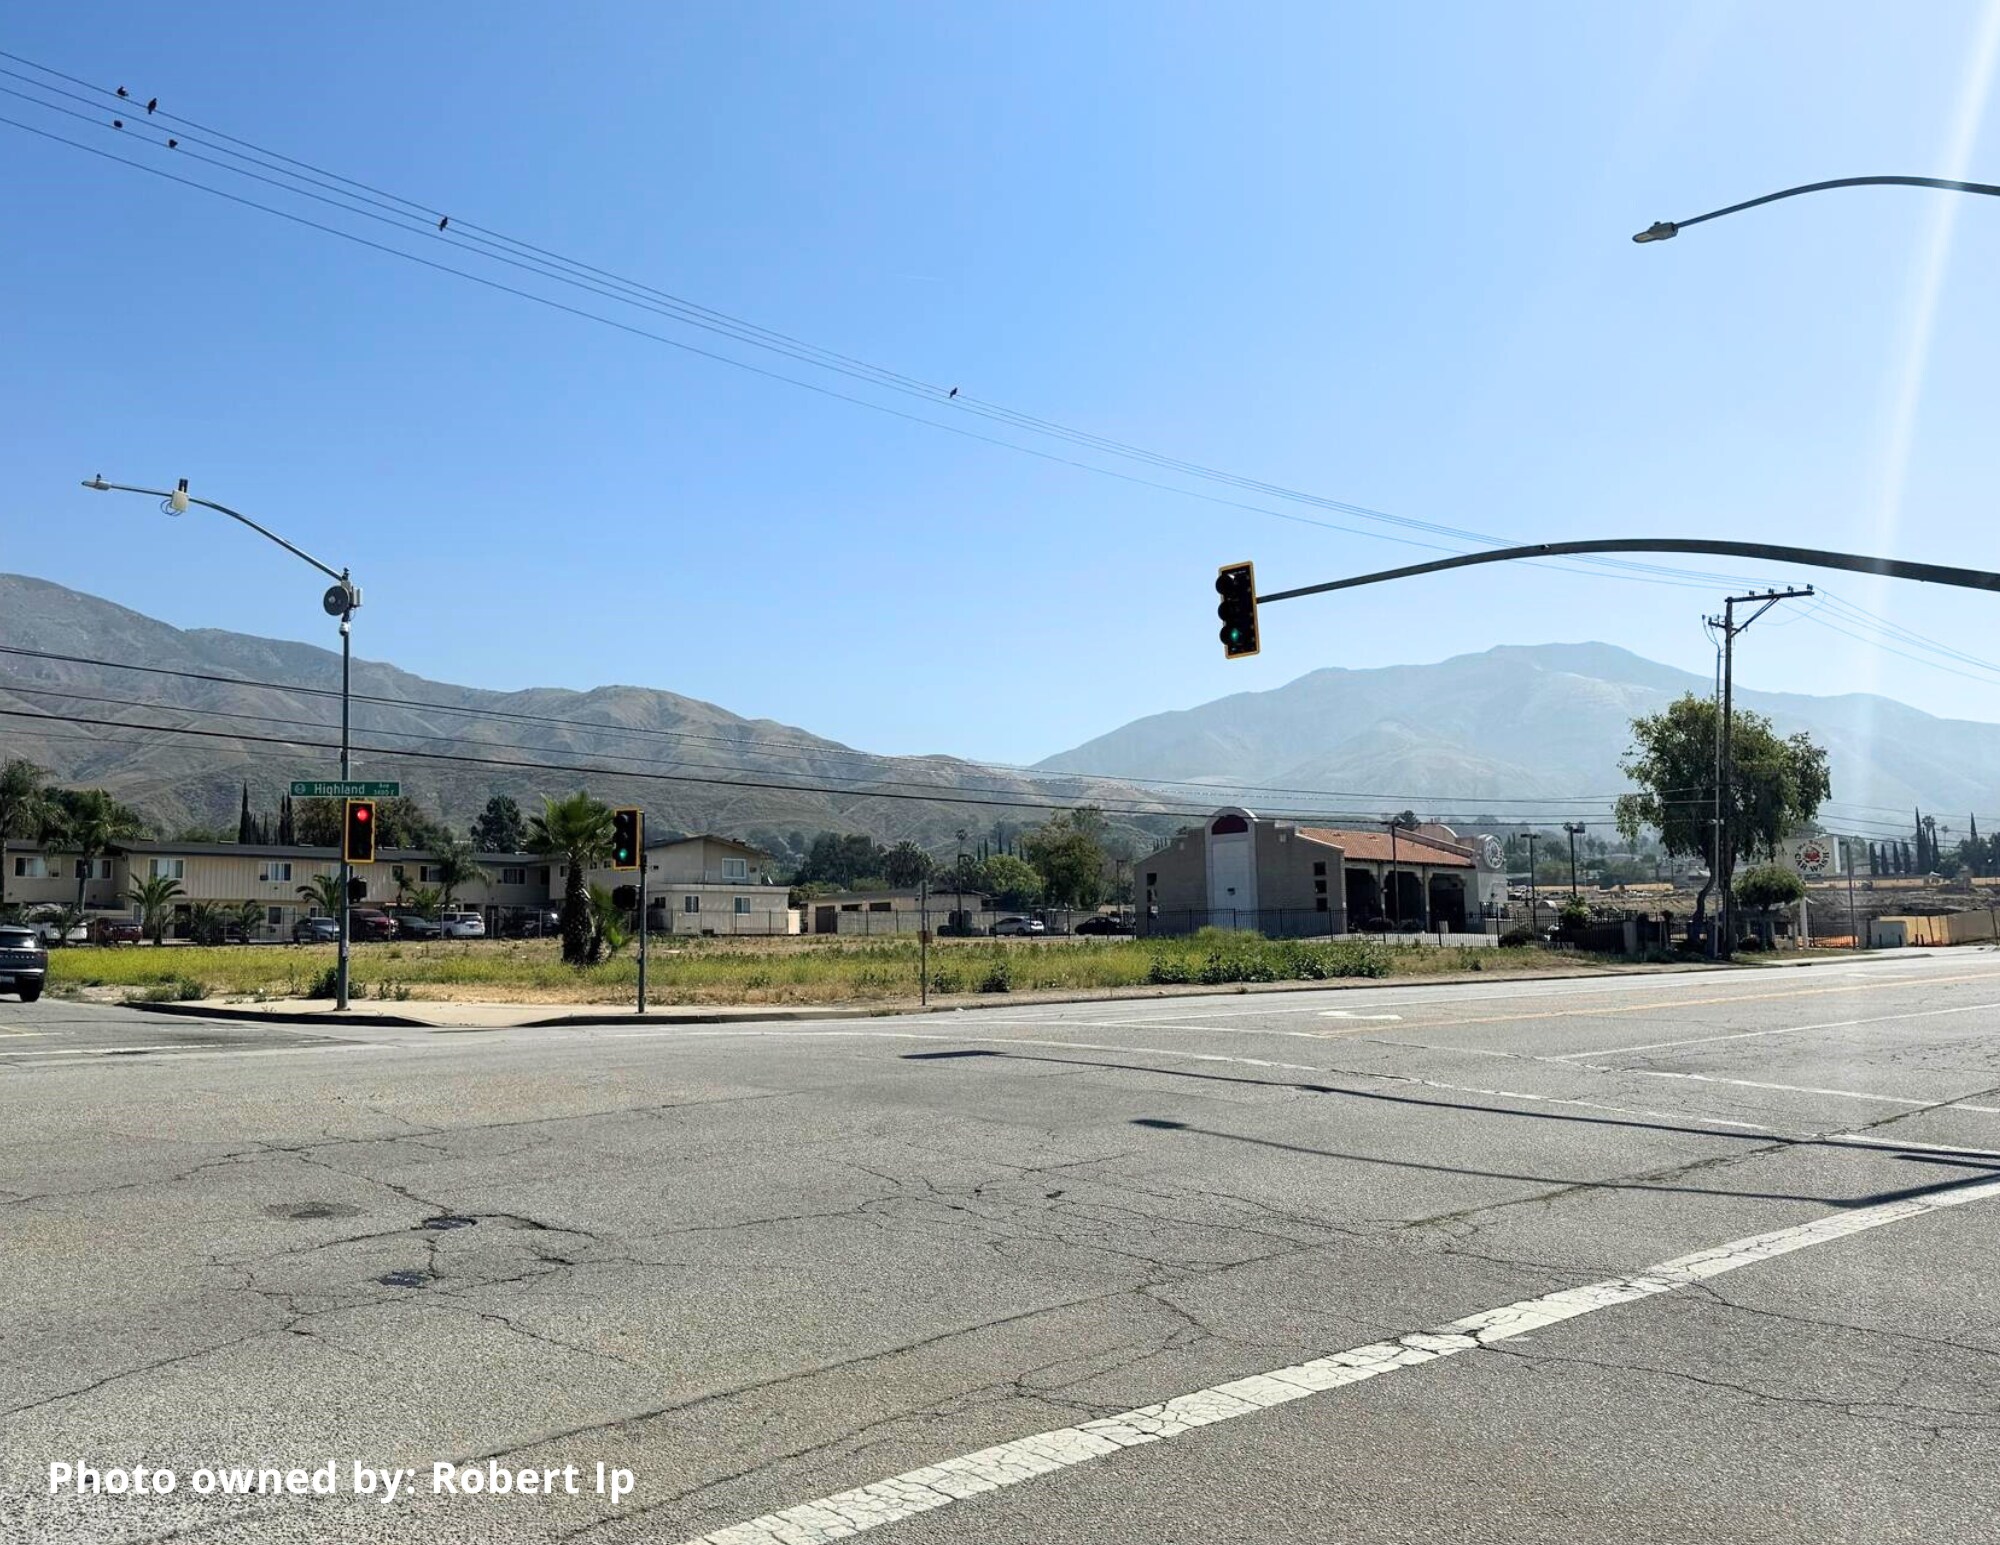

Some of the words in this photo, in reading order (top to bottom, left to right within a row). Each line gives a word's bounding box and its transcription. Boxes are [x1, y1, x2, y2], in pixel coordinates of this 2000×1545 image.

[313, 783, 366, 796] Highland
[1794, 853, 1808, 871] CAR
[1809, 852, 1830, 873] WASH
